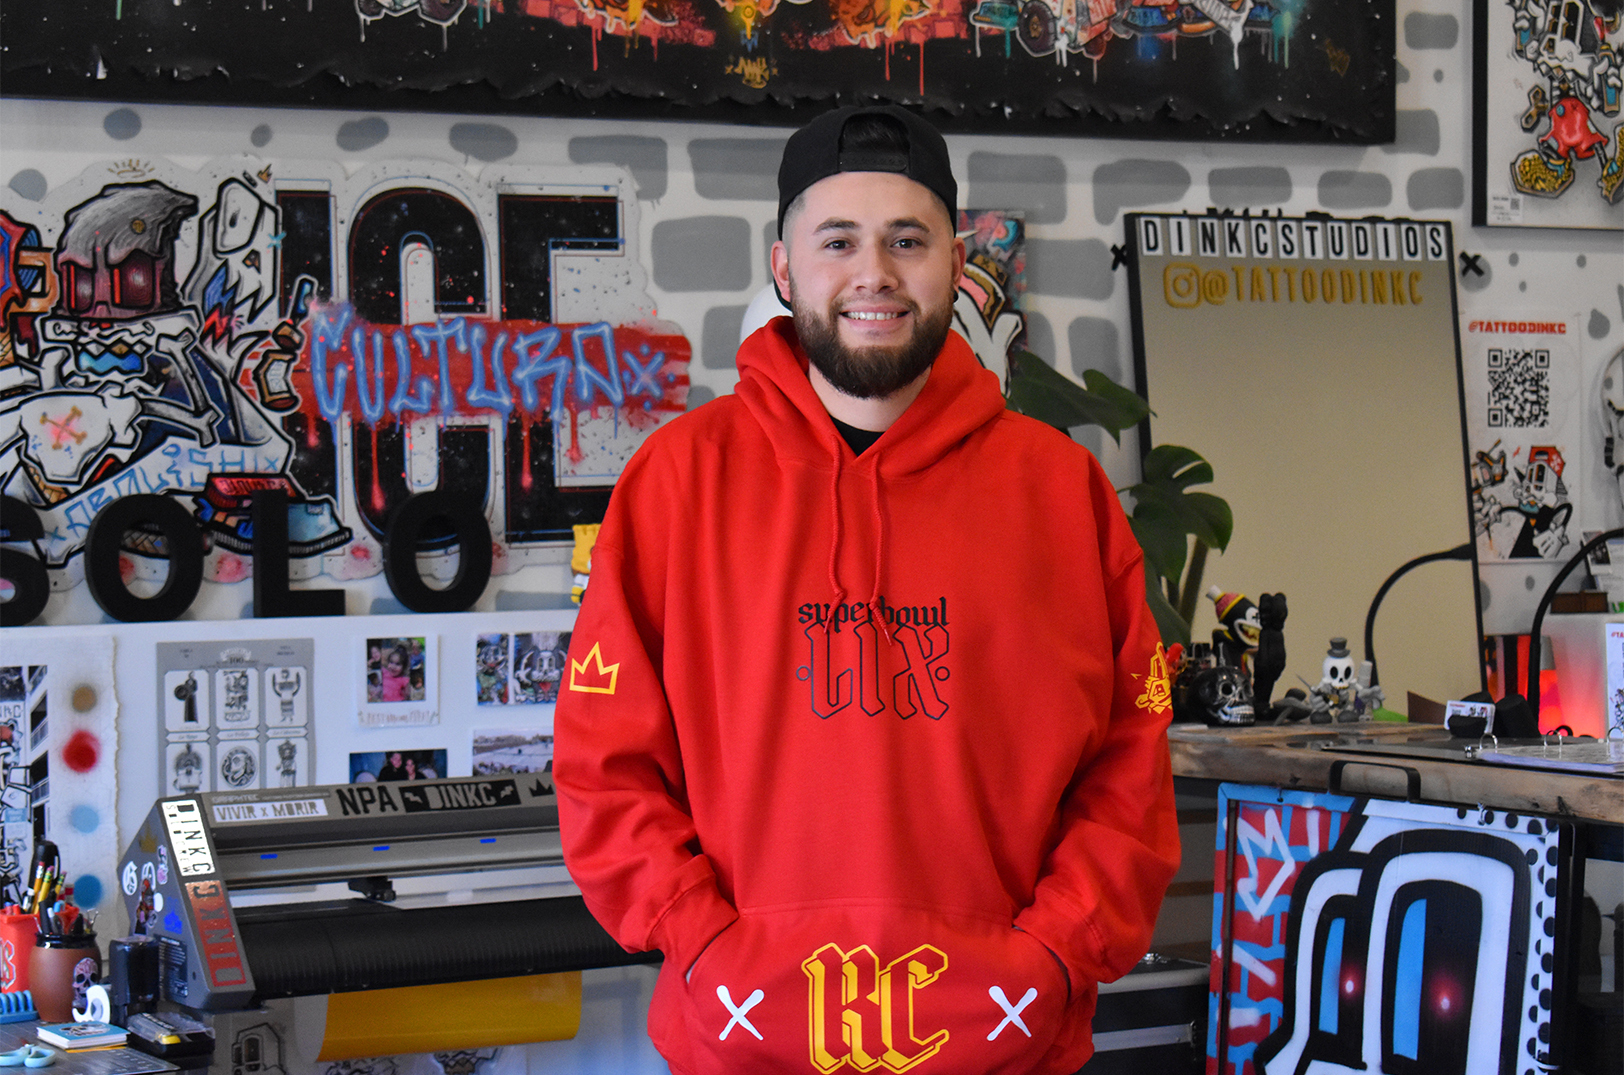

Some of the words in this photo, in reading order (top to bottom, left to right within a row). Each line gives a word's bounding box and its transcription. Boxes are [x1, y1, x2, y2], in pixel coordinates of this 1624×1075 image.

[1144, 219, 1444, 258] DINKCSTUDIOS
[1203, 264, 1423, 305] @TATTOODINKC
[1468, 320, 1567, 335] @TATTOODINKC
[310, 302, 625, 423] CULTURA
[798, 595, 950, 633] superbowl
[804, 620, 950, 720] LIX
[216, 804, 257, 821] VIVIR
[271, 800, 320, 817] MORIR
[335, 785, 398, 816] NPA
[424, 782, 496, 810] DINKC
[177, 803, 212, 872] DINKC
[192, 884, 244, 983] DINKC
